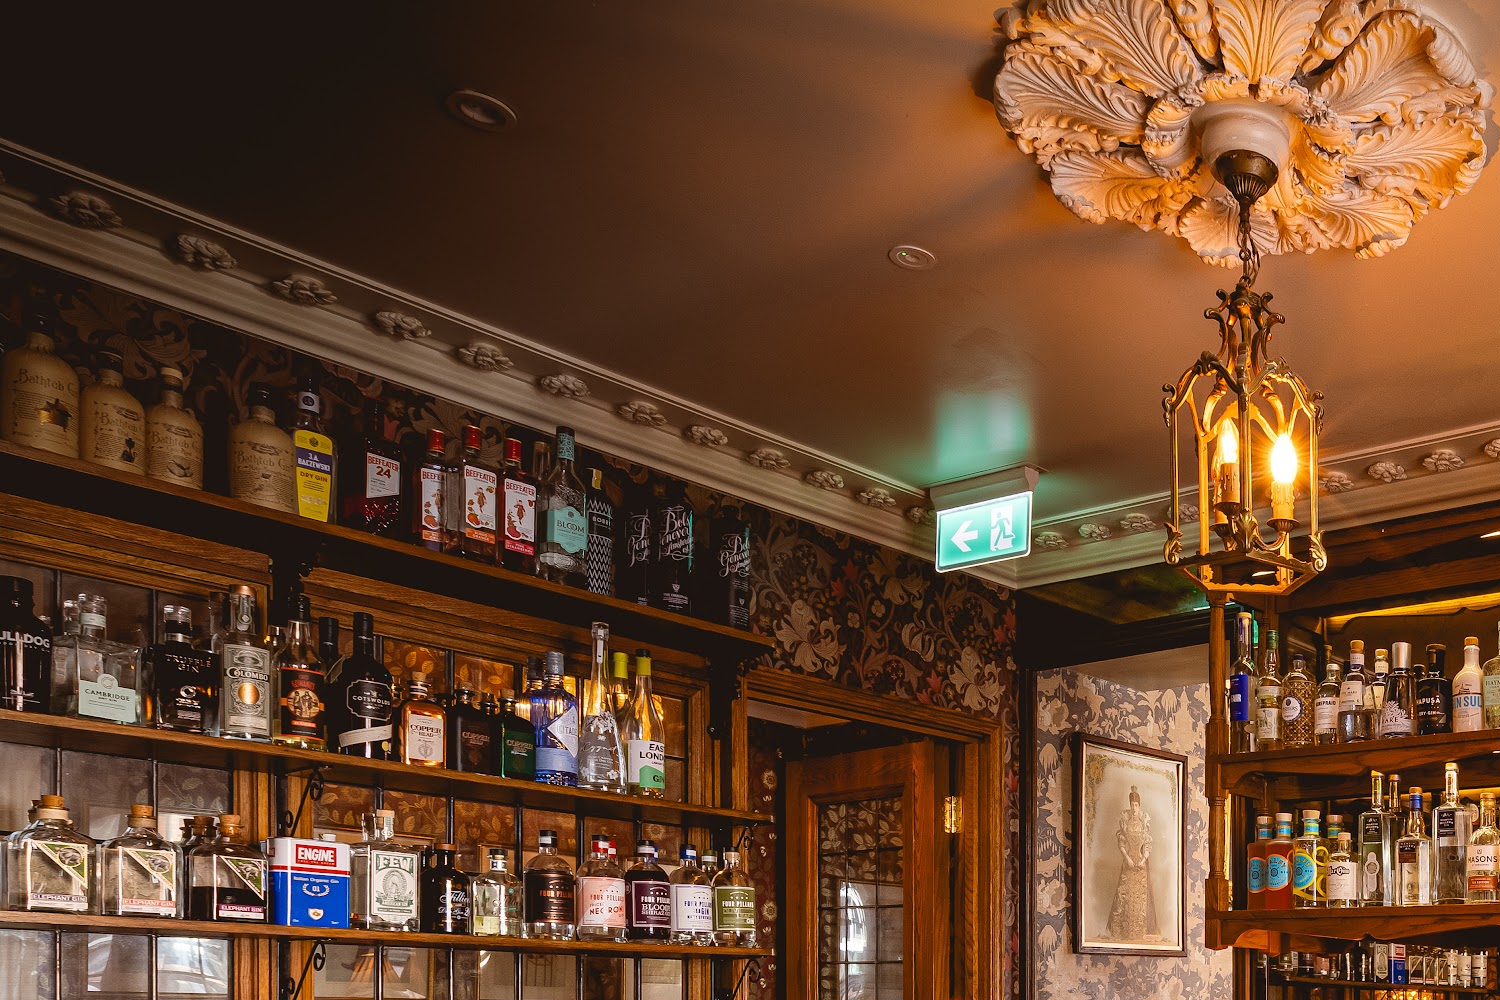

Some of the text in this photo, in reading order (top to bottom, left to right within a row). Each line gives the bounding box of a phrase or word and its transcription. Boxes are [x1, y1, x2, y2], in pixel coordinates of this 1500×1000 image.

[18, 368, 65, 391] Bathtub
[101, 412, 138, 432] Bathtub
[152, 431, 189, 448] Bathtub
[238, 451, 275, 468] Bathtub
[297, 456, 331, 472] BACZEWSKI
[368, 455, 400, 473] BEEFEATER
[300, 471, 329, 483] DRY GIN
[376, 466, 392, 479] 24
[422, 471, 445, 481] BEEFE
[465, 468, 496, 485] BEEFEATER
[505, 481, 535, 497] BEEFEATER
[557, 520, 585, 534] BLOOM
[661, 526, 690, 547] enever
[165, 653, 212, 669] TRUFFLE
[178, 664, 200, 674] GIN
[226, 666, 269, 682] COLOMBO
[85, 688, 131, 702] CAMBRIDGE
[352, 695, 391, 706] COTSWOLDS
[1463, 695, 1482, 707] SUL
[410, 724, 442, 734] COPPER
[297, 848, 335, 863] ENGINE
[378, 855, 413, 873] FEW
[33, 893, 69, 902] ELEPHANT
[125, 899, 159, 908] ELEPHANT
